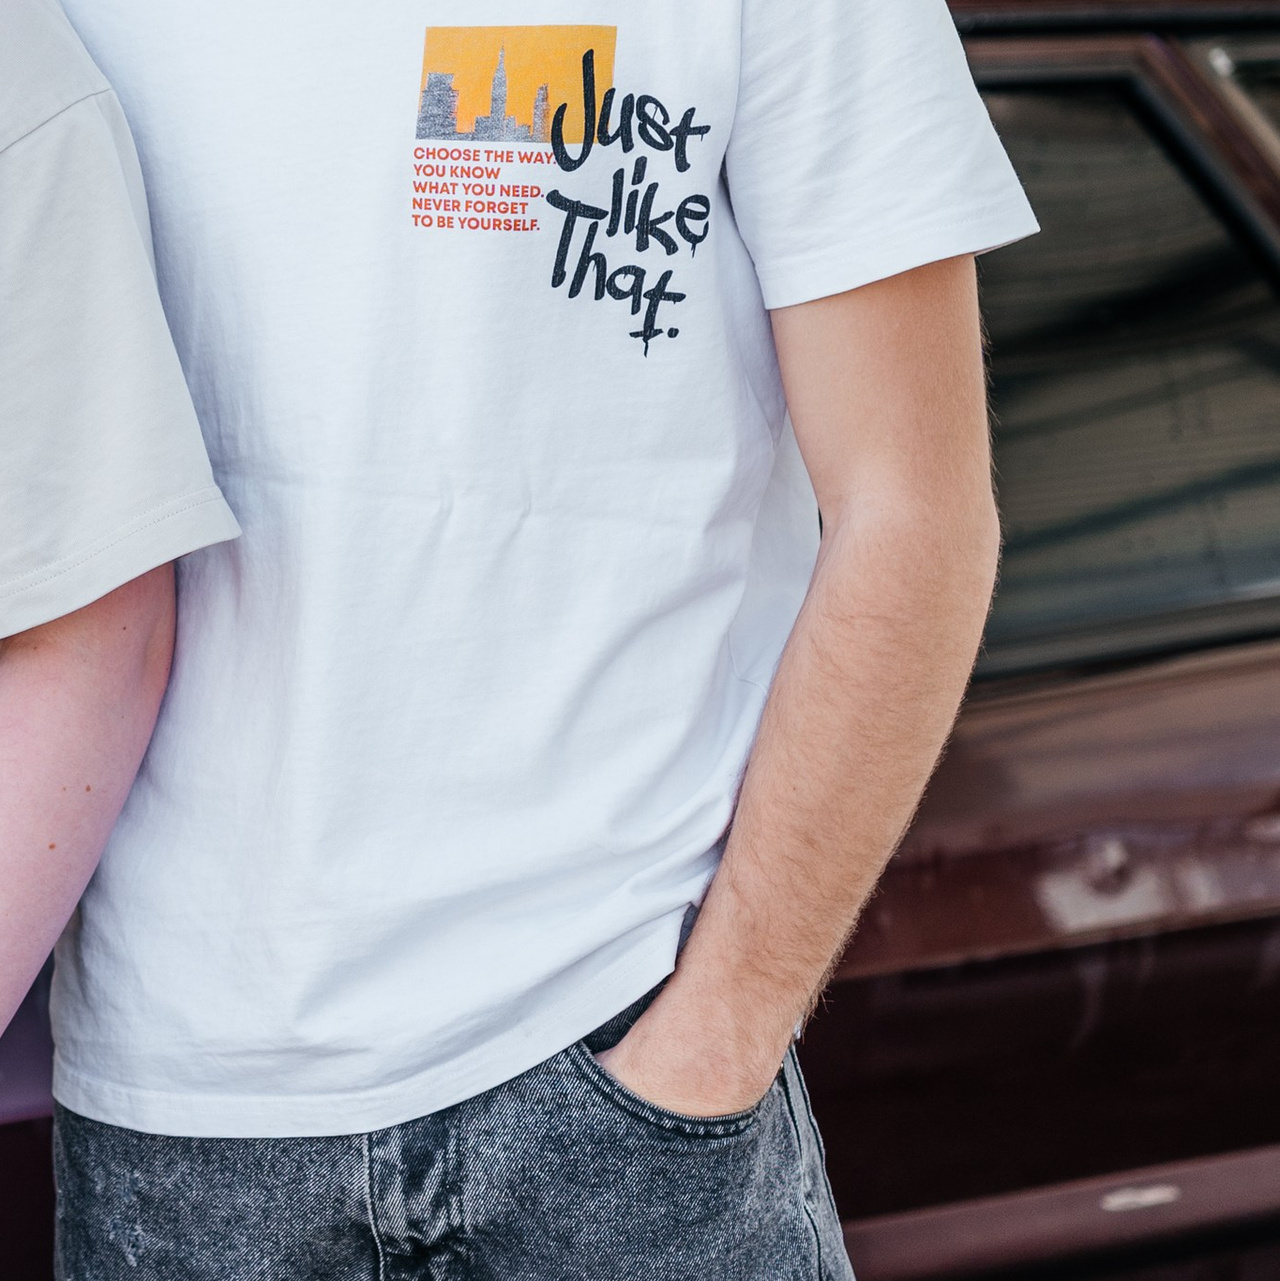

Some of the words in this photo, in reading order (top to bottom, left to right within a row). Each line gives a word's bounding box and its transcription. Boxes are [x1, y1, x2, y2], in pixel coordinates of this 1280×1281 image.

[551, 48, 711, 172] Just
[413, 147, 481, 162] CHOOSE
[484, 150, 514, 163] THE
[517, 151, 557, 165] WAY.
[413, 164, 446, 178] YOU
[450, 166, 501, 179] KNOW
[412, 181, 458, 195] WHAT
[462, 183, 496, 197] YOU
[499, 184, 545, 198] NEED.
[412, 197, 461, 212] NEVER
[464, 200, 528, 215] FORGET
[606, 155, 711, 258] like
[412, 214, 433, 227] TO
[437, 216, 454, 229] BE
[458, 217, 540, 231] YOURSELF.
